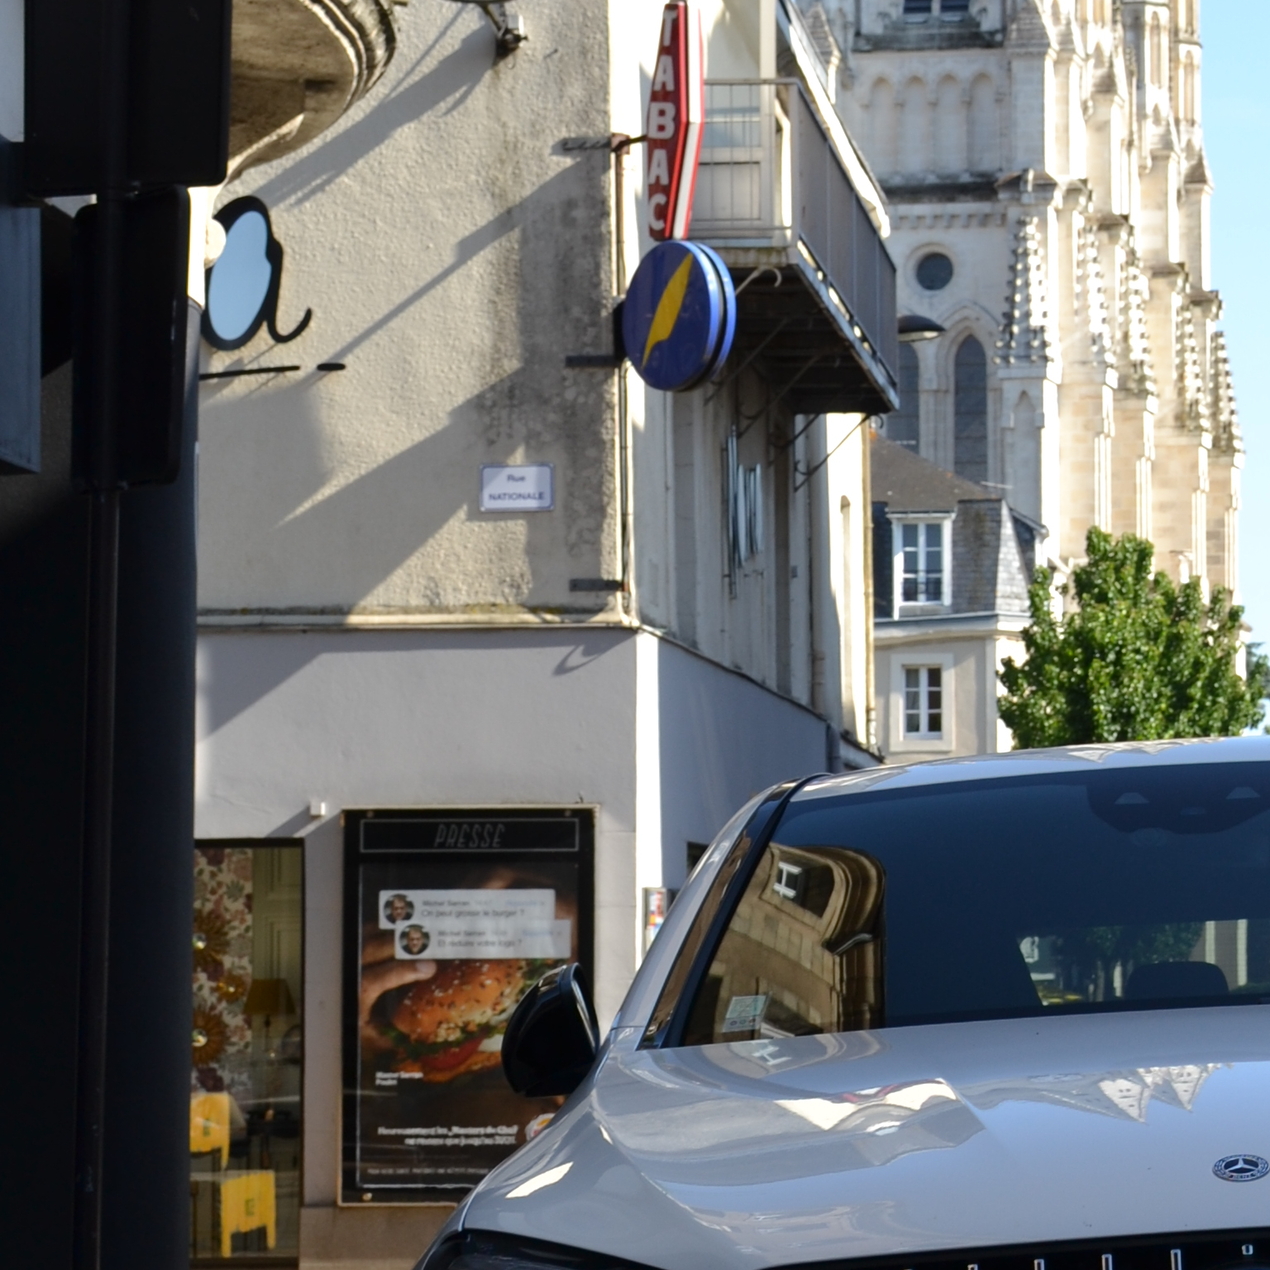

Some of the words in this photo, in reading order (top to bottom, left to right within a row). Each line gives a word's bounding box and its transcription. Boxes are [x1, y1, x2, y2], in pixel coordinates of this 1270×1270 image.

[647, 8, 678, 233] TABAC
[489, 492, 544, 500] NATIONALE
[434, 823, 505, 847] PRESSE
